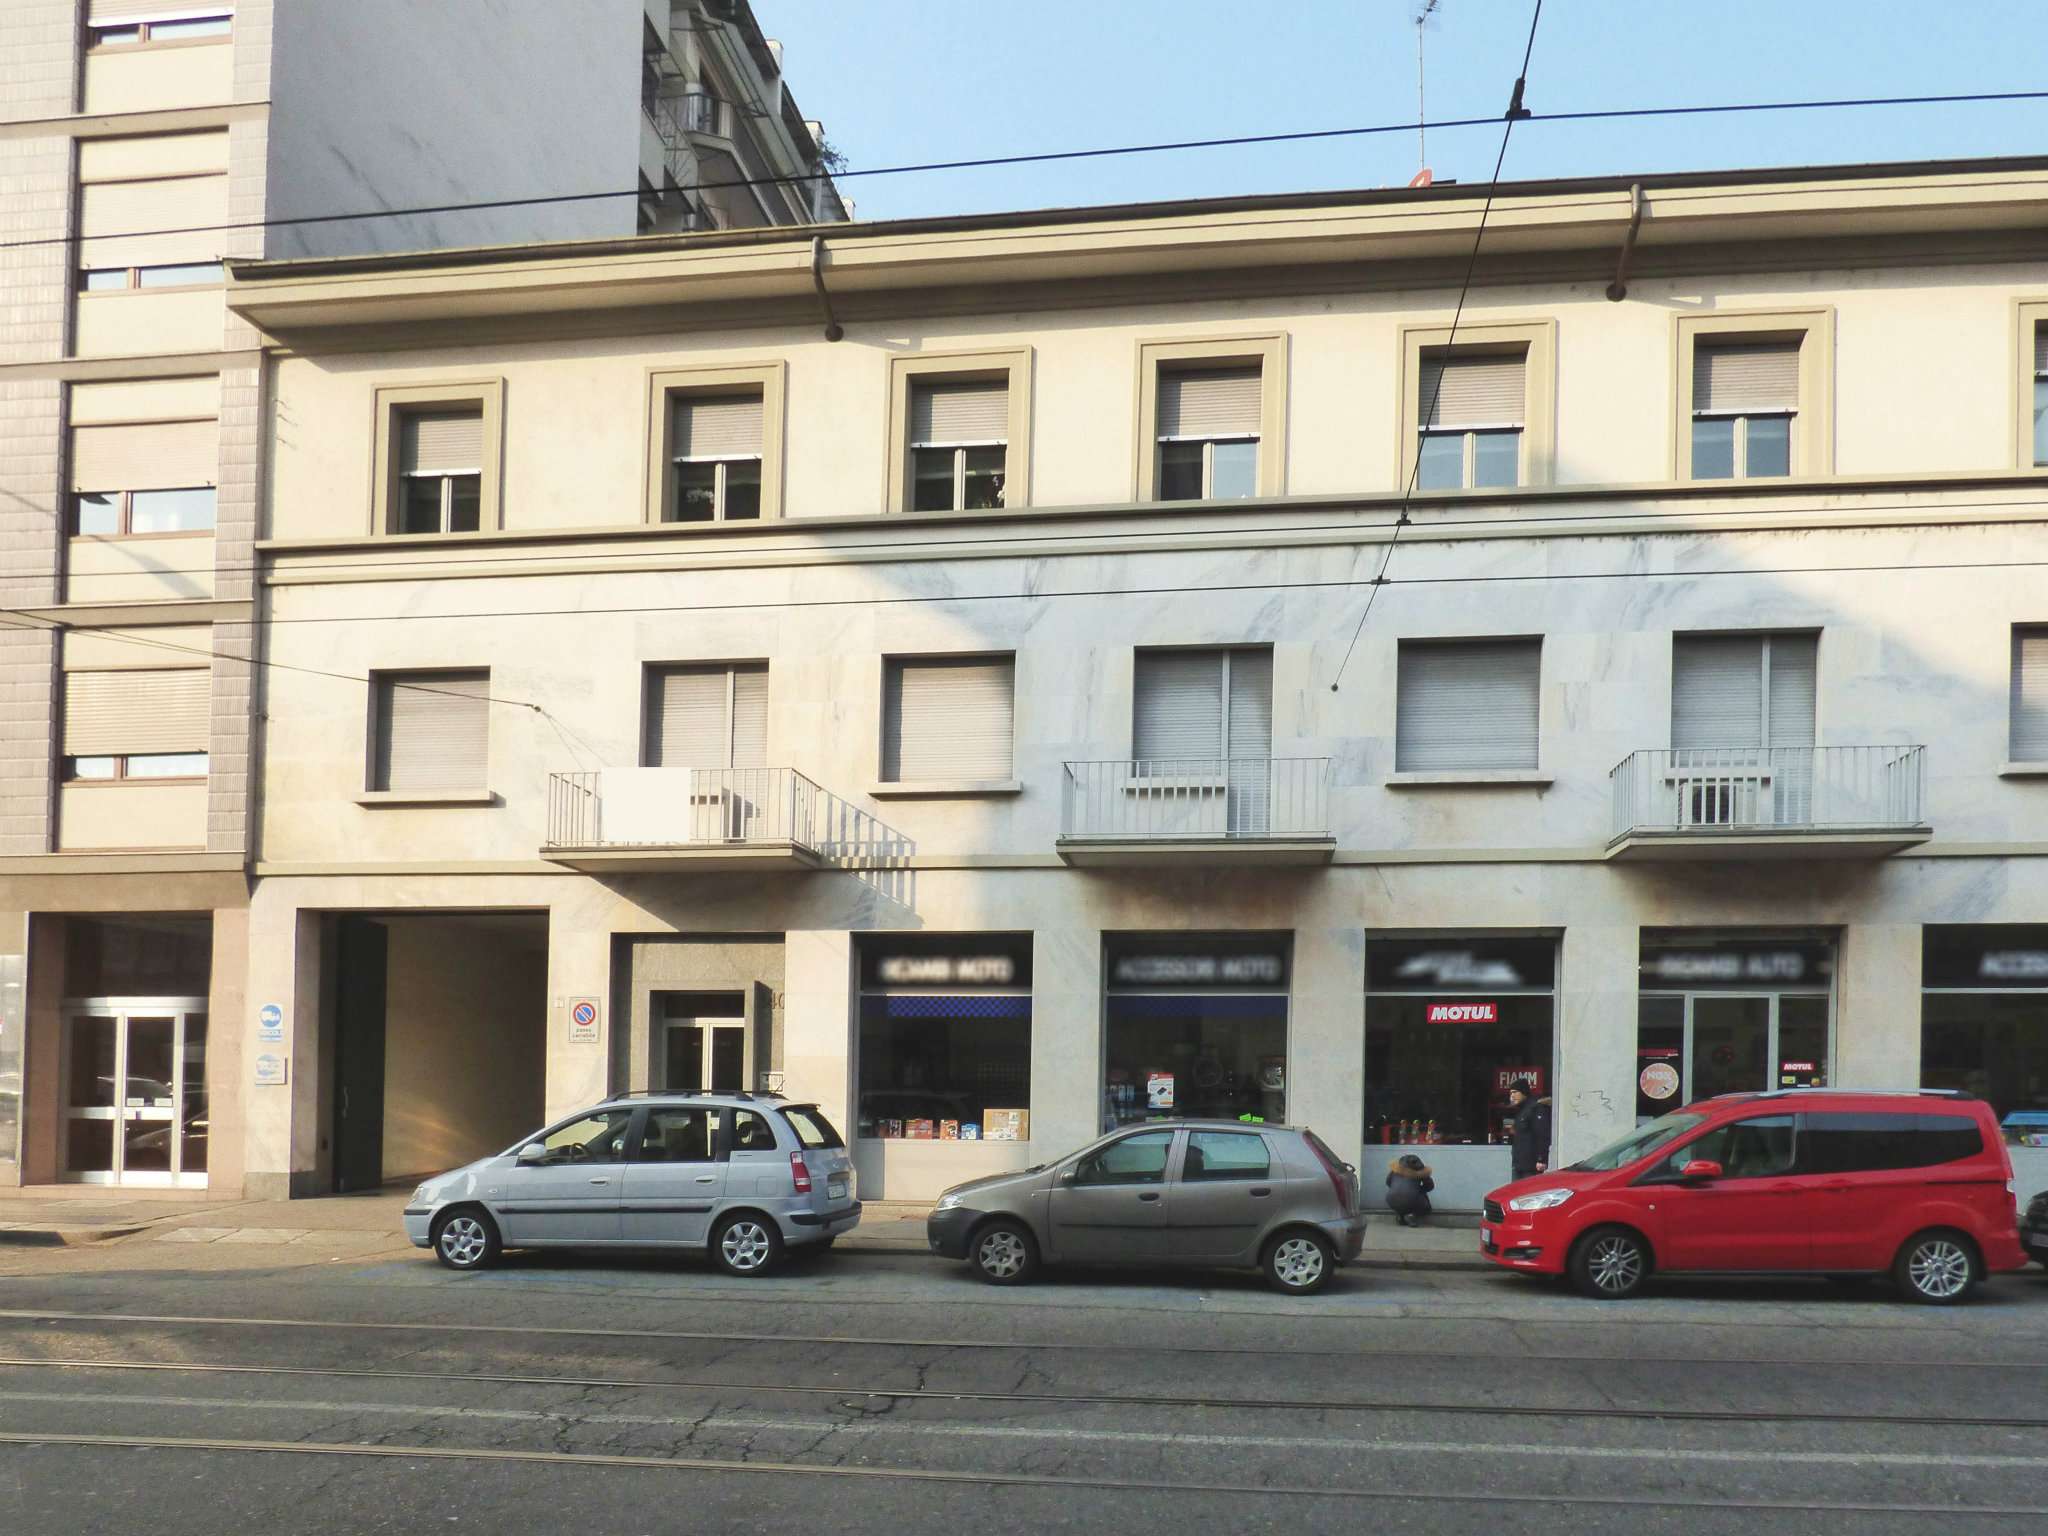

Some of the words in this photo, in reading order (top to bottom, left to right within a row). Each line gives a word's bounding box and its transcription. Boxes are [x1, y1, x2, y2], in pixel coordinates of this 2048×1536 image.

[1431, 1006, 1494, 1020] MOTUL
[1783, 1063, 1813, 1071] MOTUL
[1499, 1071, 1538, 1086] FIAMM
